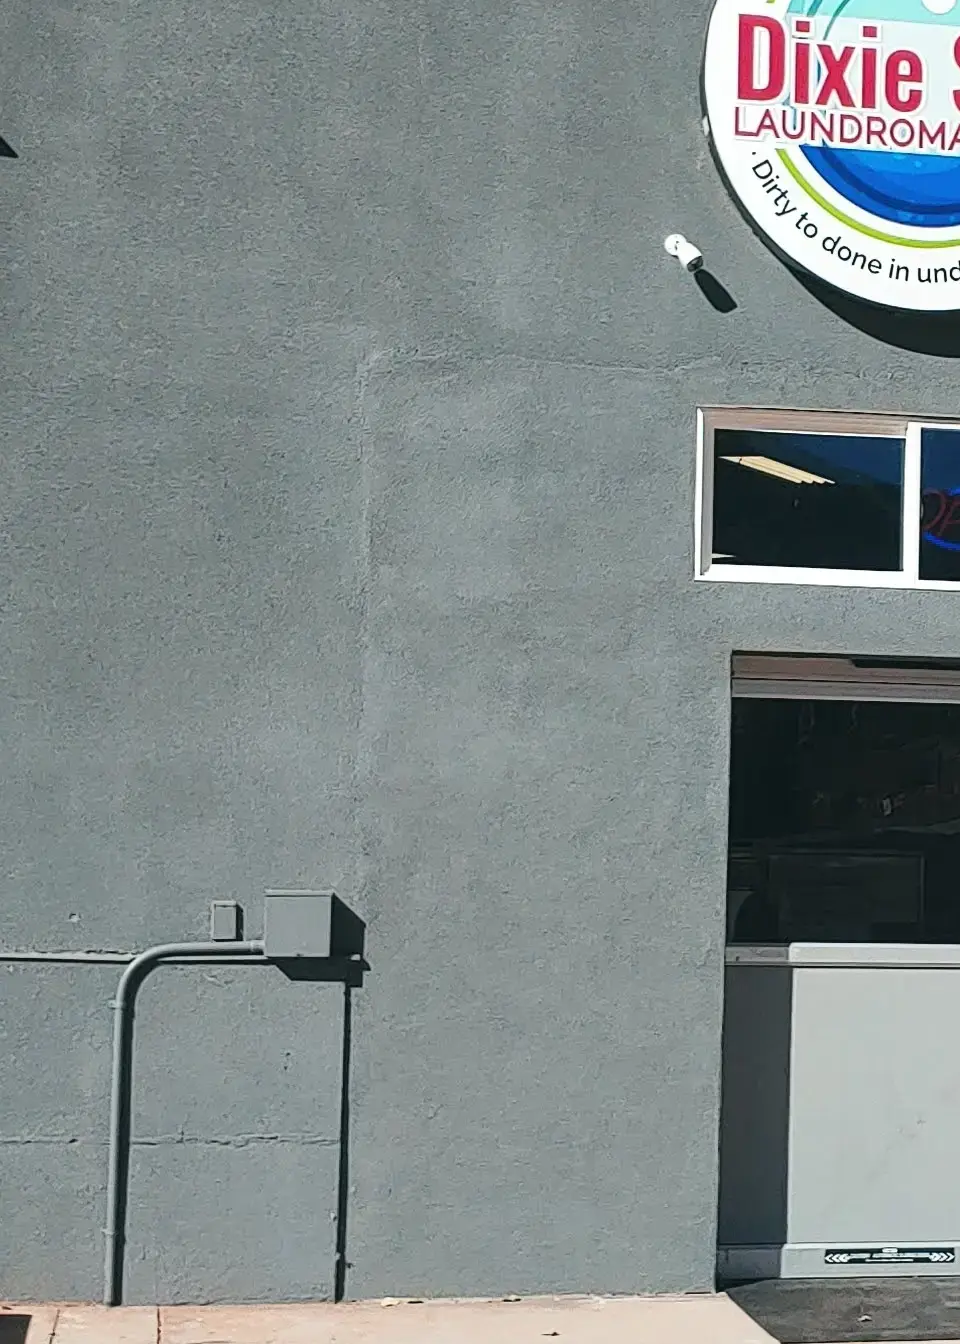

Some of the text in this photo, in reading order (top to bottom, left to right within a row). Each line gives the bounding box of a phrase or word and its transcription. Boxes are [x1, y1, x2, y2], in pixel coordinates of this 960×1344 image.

[738, 13, 923, 112] Dixie
[752, 159, 797, 217] Dirty
[795, 212, 818, 239] to
[822, 236, 882, 275] done
[888, 258, 909, 282] in
